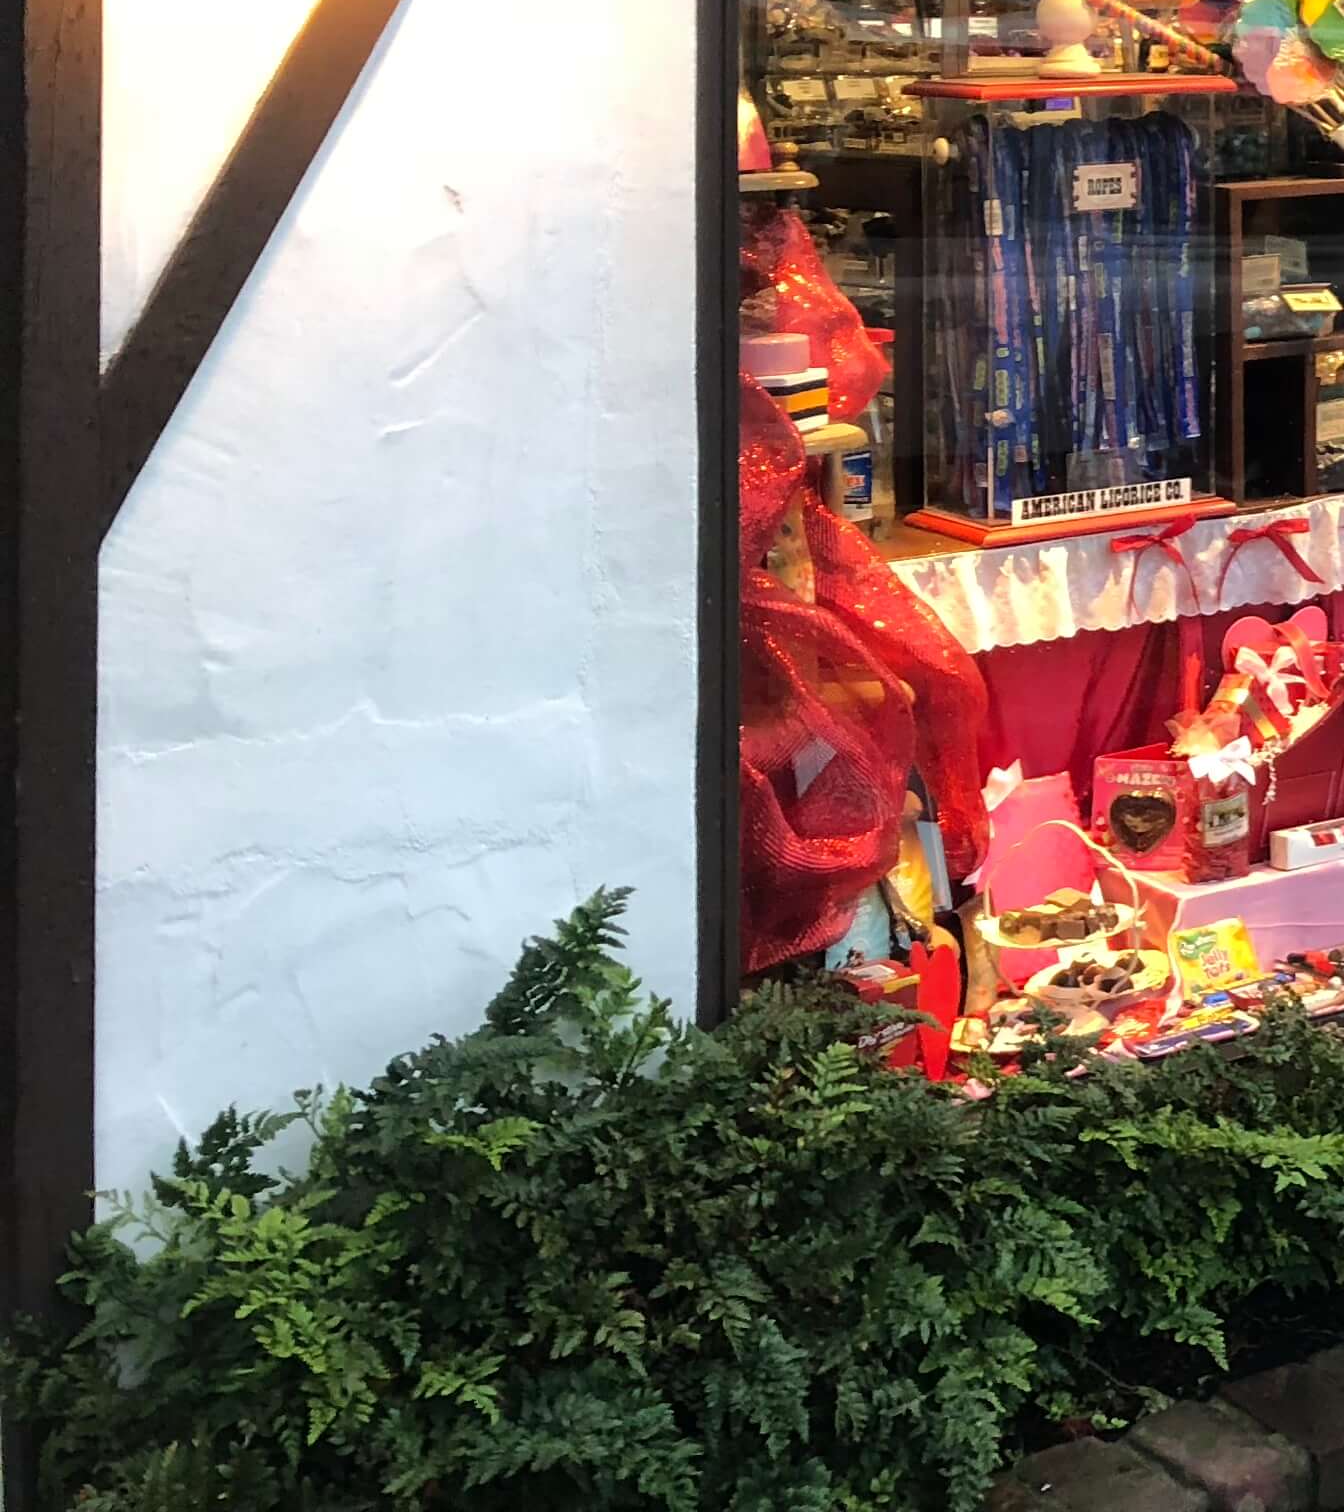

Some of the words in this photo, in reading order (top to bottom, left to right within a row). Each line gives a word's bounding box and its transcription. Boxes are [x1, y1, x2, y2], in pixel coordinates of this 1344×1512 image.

[1021, 491, 1096, 520] AMERICAN
[1100, 483, 1161, 509] LICORICE
[1165, 481, 1184, 501] CO.
